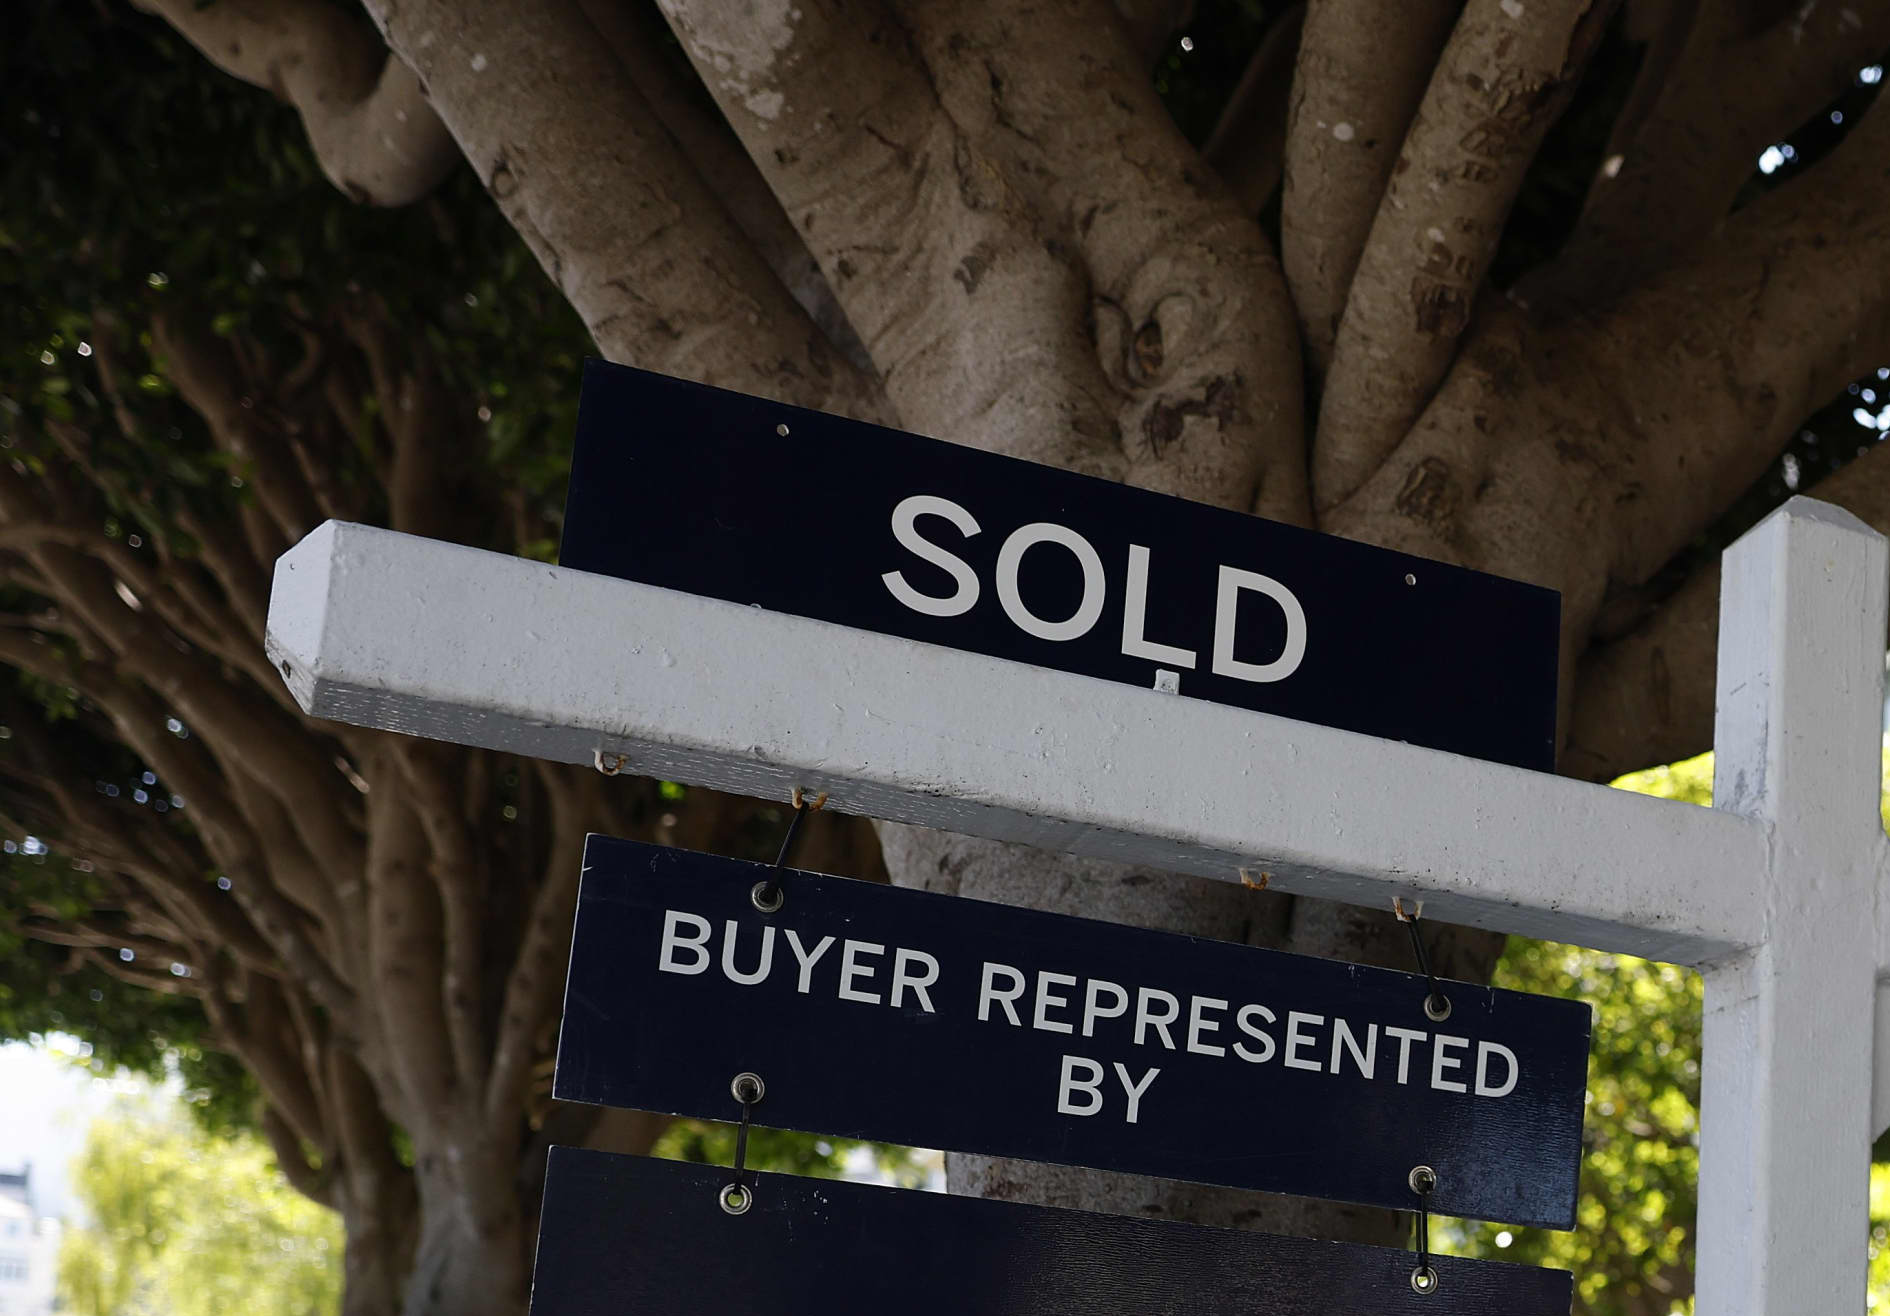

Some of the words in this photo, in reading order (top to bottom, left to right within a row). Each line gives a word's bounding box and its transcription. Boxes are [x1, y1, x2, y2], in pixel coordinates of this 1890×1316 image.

[881, 495, 1307, 683] SOLD
[658, 909, 940, 1013] BUYER
[977, 961, 1519, 1098] REPRESENTED
[1057, 1054, 1161, 1124] BY
